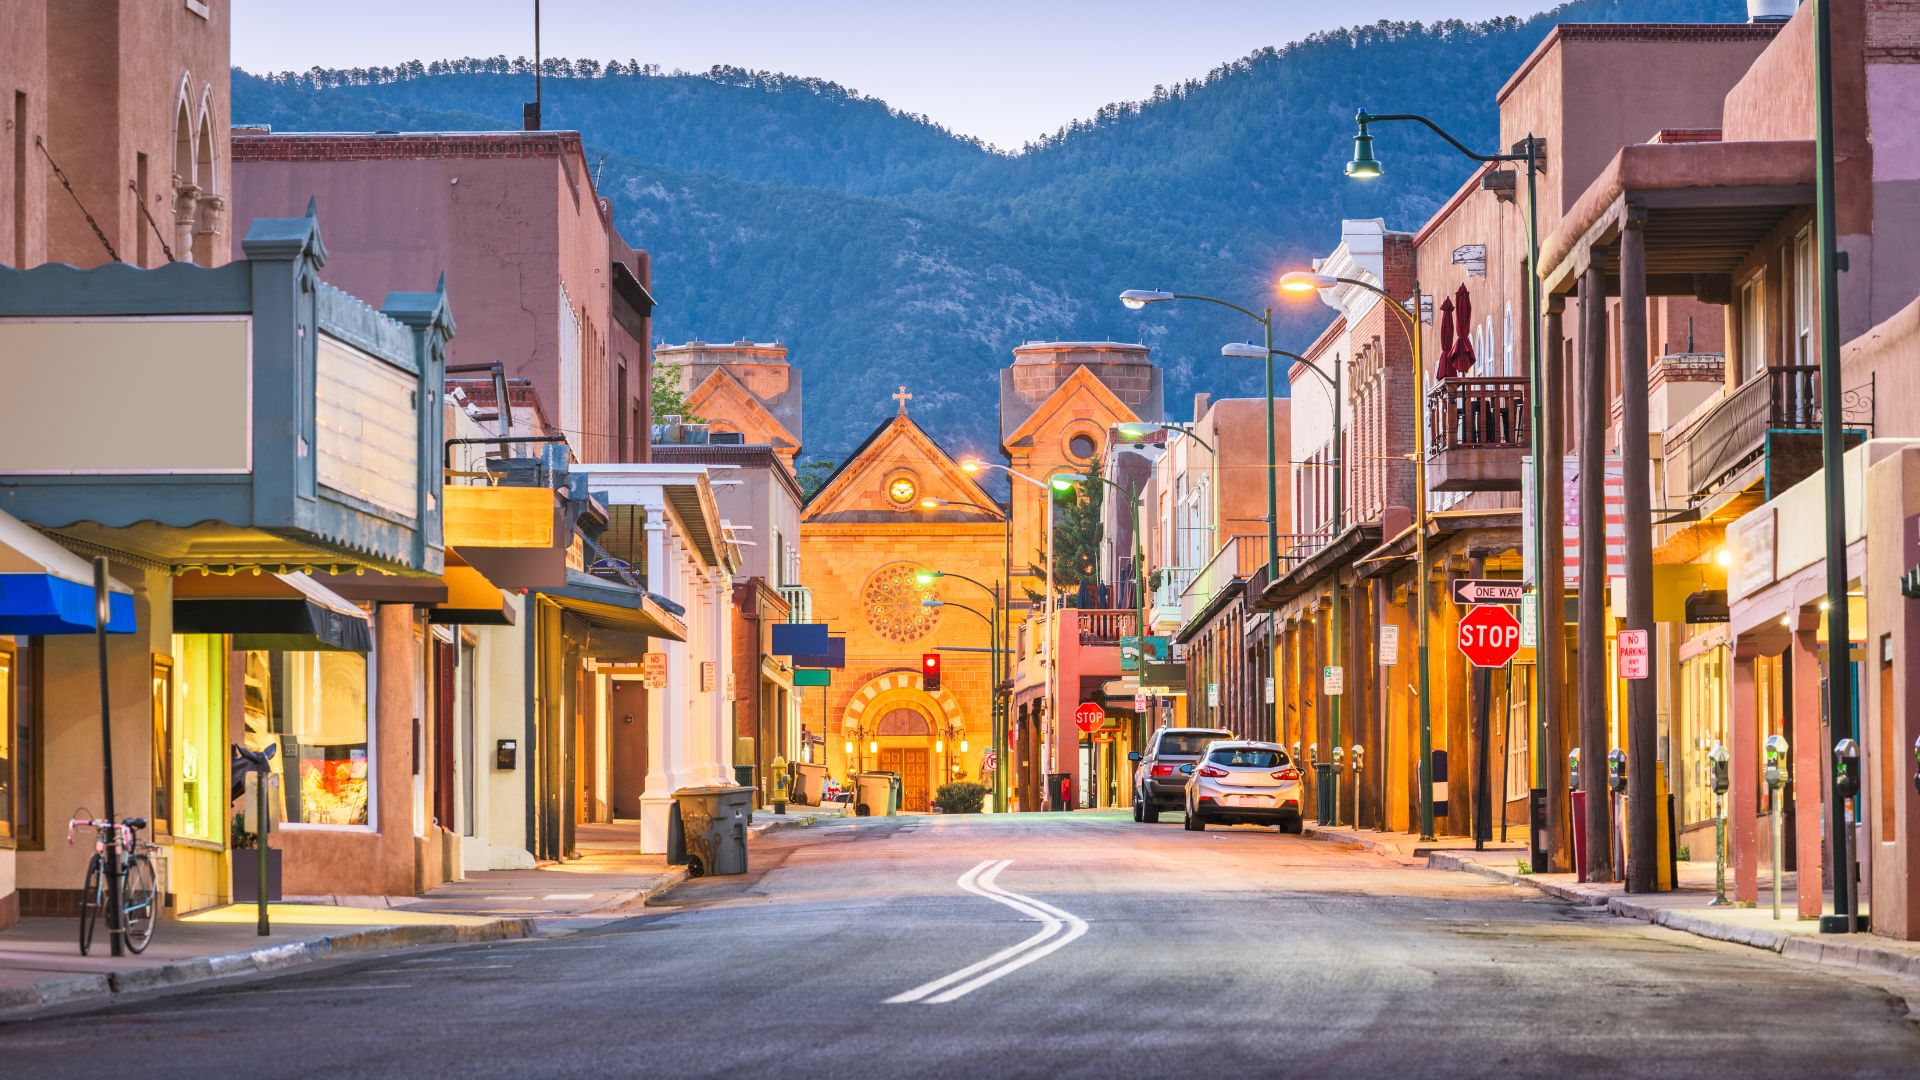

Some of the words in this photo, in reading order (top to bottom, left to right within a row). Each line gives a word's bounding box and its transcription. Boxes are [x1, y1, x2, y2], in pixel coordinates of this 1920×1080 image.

[1476, 588, 1495, 597] ONE
[1499, 588, 1519, 597] WAY
[1461, 624, 1518, 648] STOP
[1628, 636, 1639, 644] NO
[1620, 648, 1647, 656] PARKING
[1076, 712, 1103, 723] STOP
